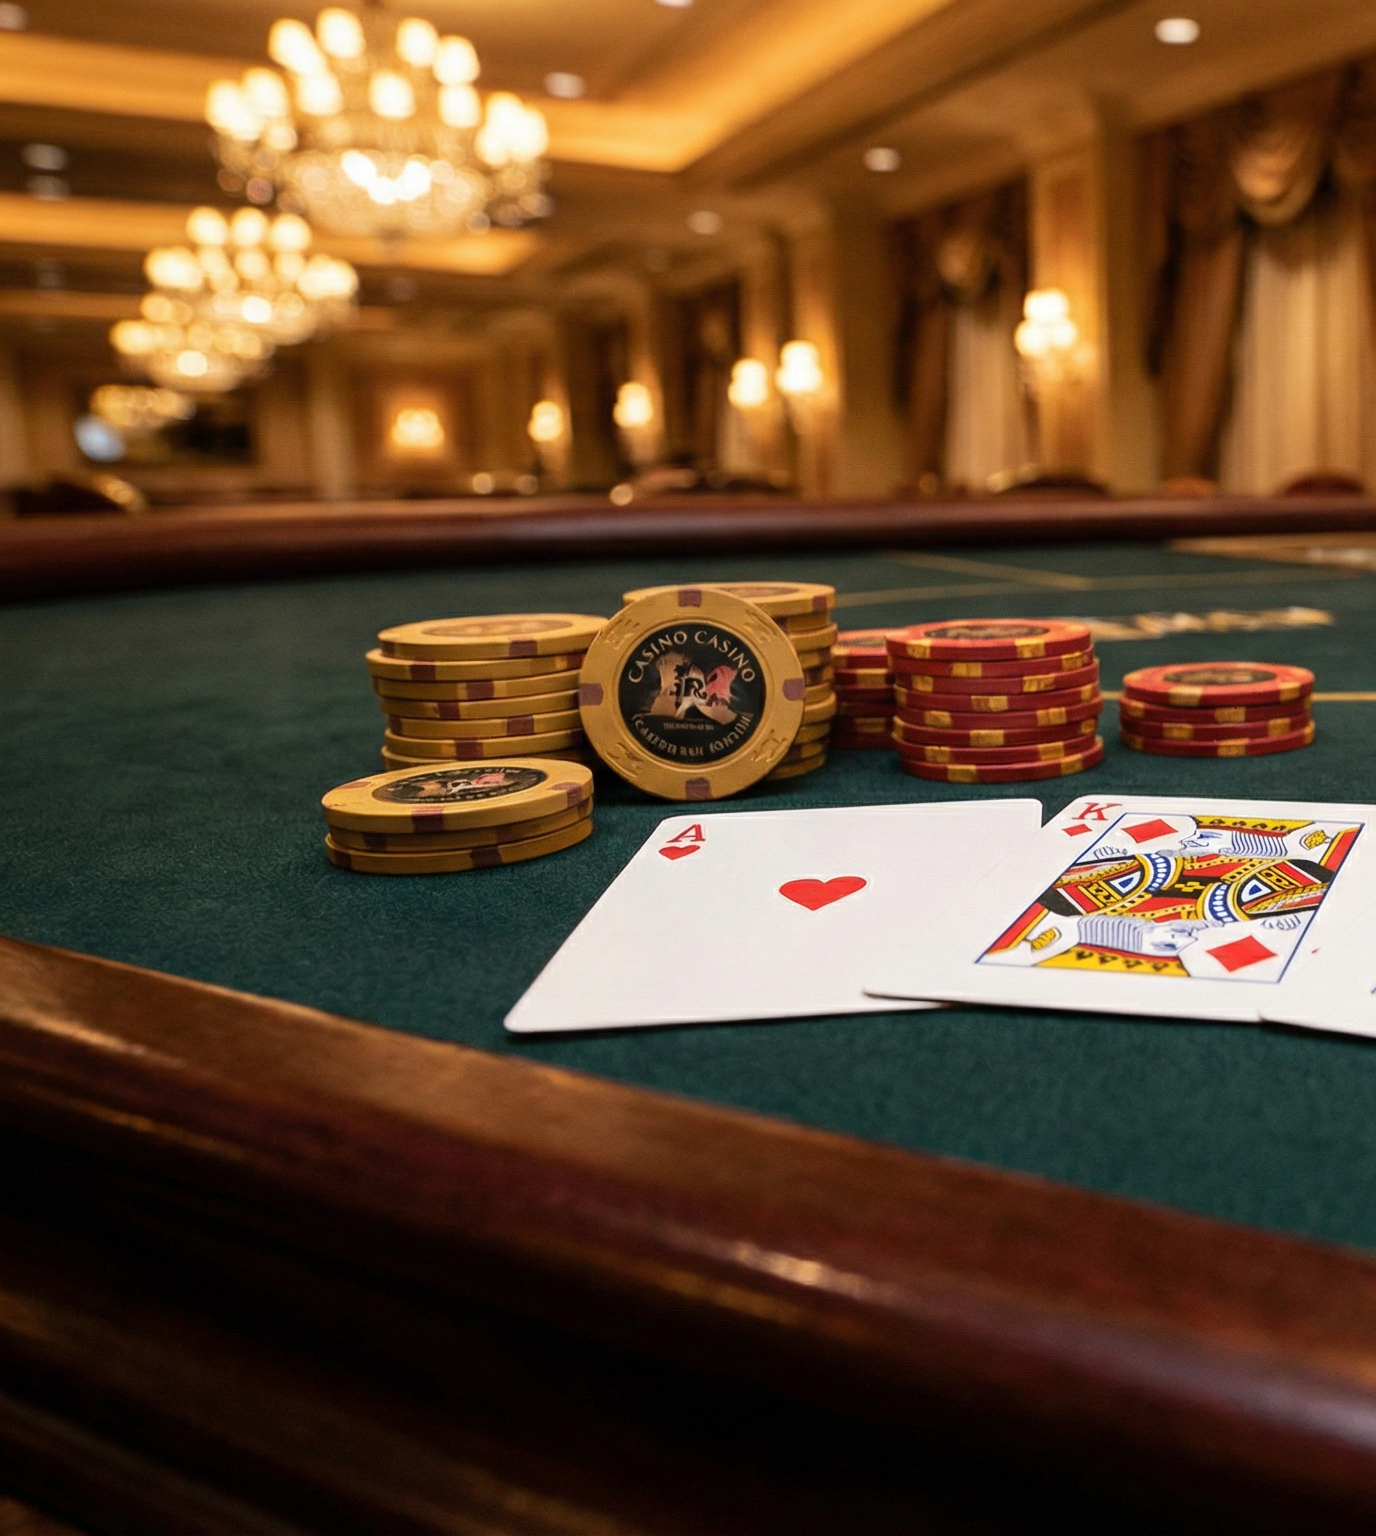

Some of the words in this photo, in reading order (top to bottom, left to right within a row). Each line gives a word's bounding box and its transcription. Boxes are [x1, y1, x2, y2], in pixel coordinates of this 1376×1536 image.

[628, 630, 688, 684] CASINO
[694, 630, 756, 682] CASINO
[1071, 802, 1123, 821] K
[666, 823, 706, 843] A
